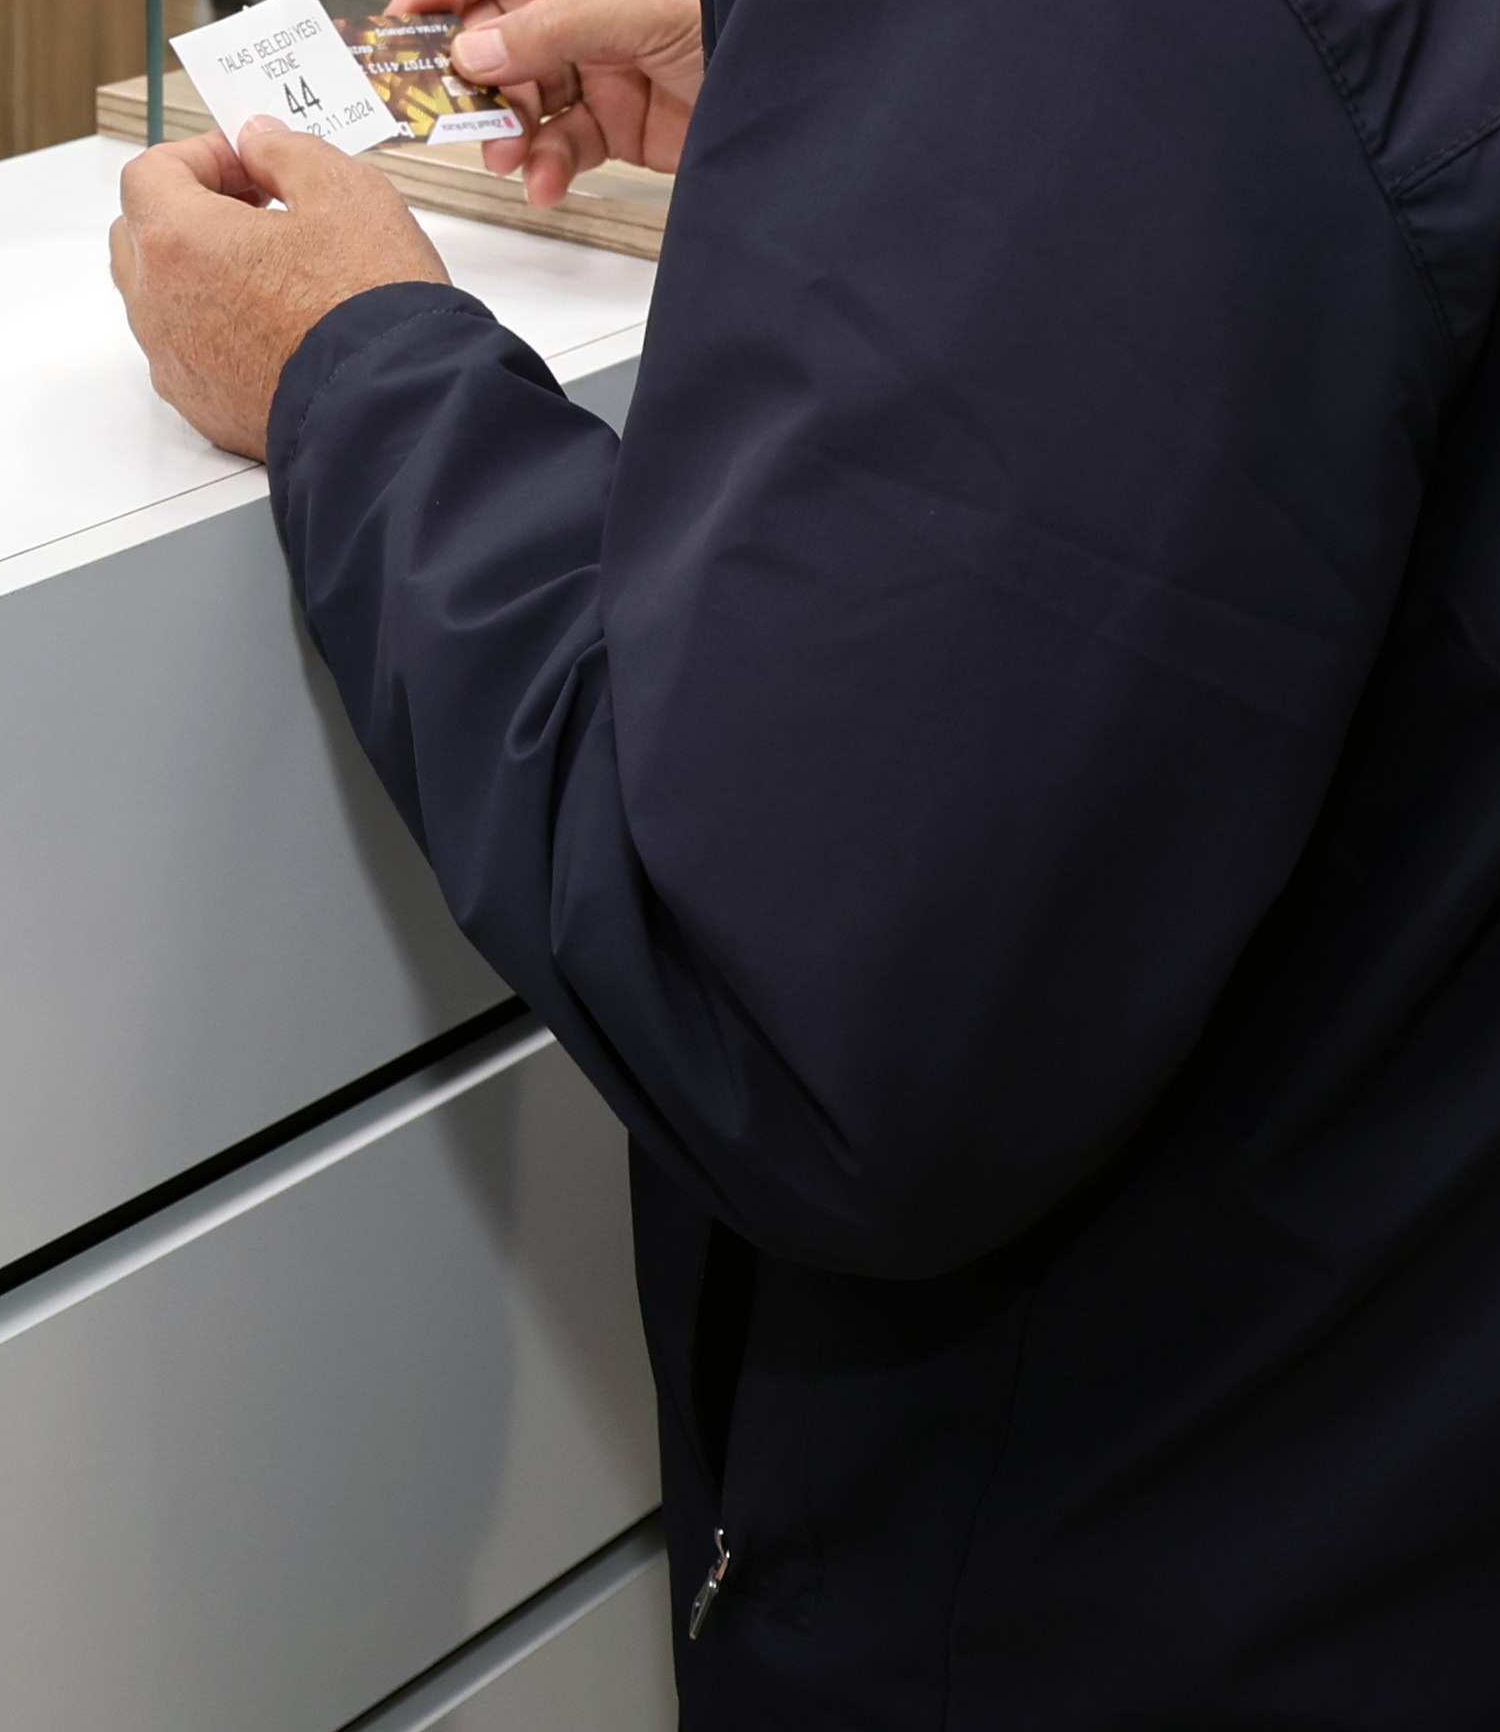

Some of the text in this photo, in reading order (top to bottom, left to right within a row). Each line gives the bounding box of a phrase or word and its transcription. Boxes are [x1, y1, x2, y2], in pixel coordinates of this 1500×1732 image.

[217, 48, 254, 74] TALAS
[260, 53, 300, 80] VEZNE
[283, 76, 323, 118] 44
